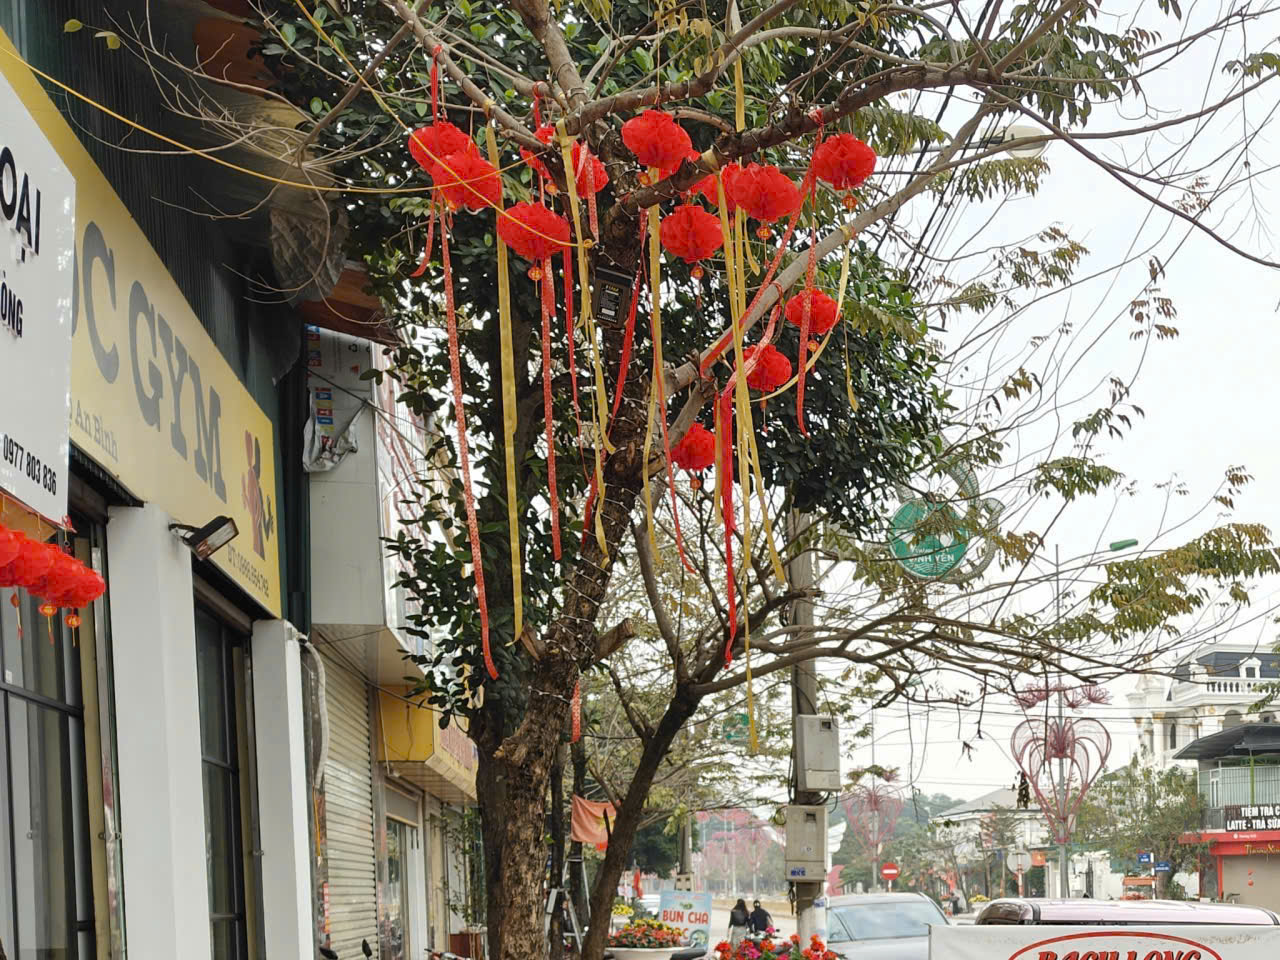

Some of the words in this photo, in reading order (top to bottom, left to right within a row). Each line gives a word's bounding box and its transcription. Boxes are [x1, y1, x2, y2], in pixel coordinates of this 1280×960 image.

[128, 280, 226, 505] GYM
[3, 433, 24, 471] 0977
[26, 451, 41, 484] 803
[42, 464, 57, 496] 836
[1227, 819, 1247, 831] LATTE
[1252, 817, 1267, 830] TRÀ
